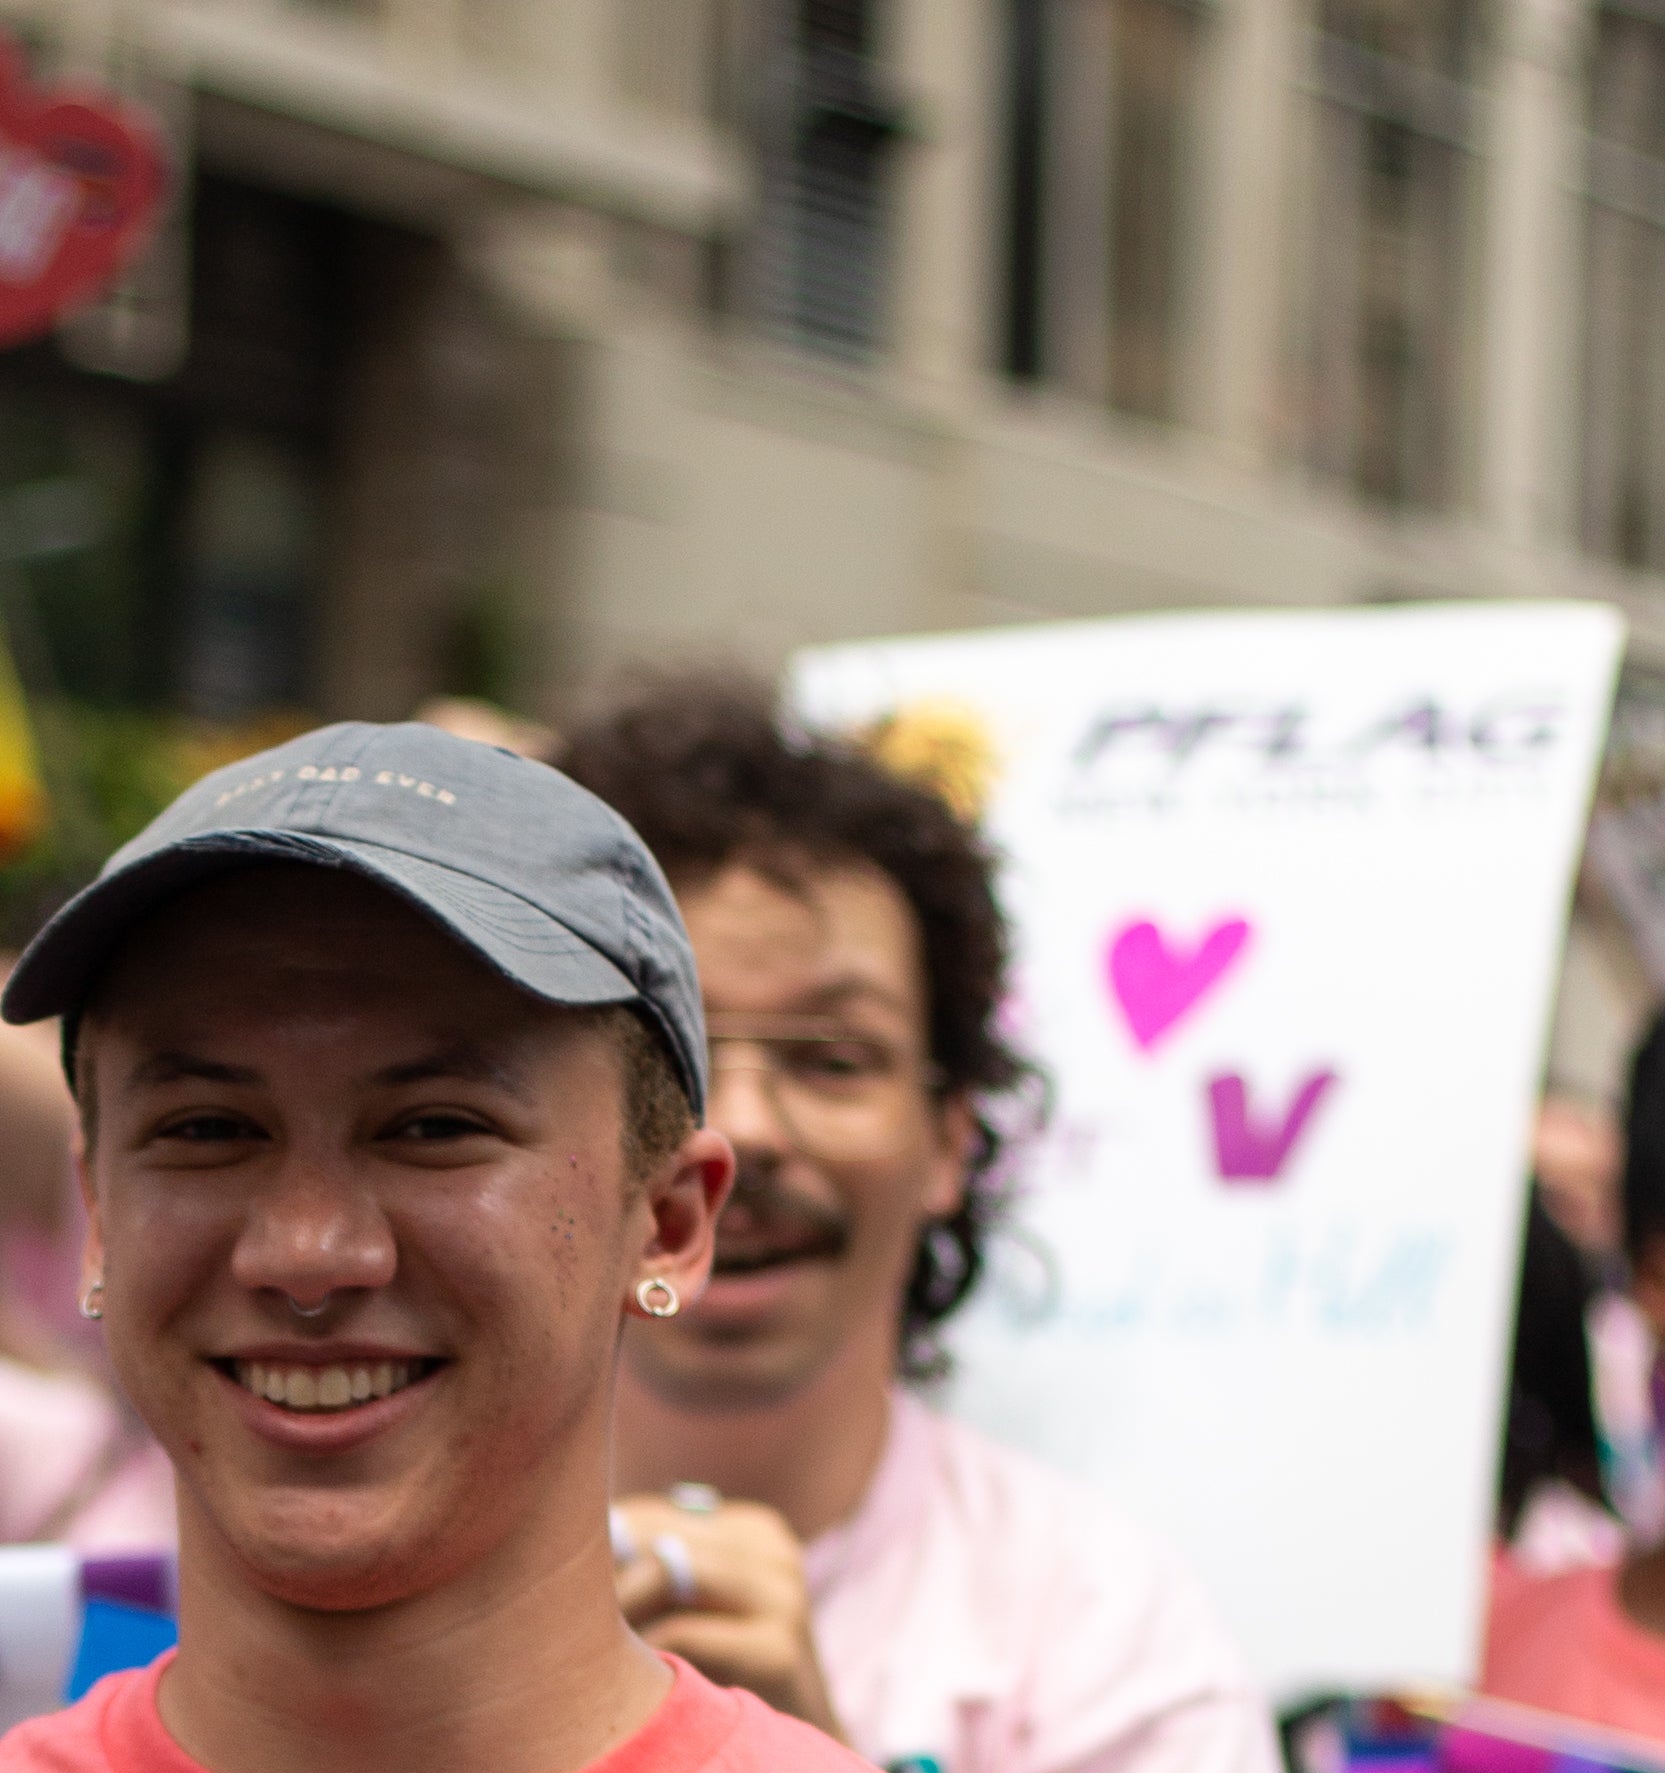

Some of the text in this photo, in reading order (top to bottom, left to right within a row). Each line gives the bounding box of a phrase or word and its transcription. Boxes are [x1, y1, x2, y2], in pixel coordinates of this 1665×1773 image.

[1070, 690, 1566, 769] PFLAG
[296, 765, 361, 782] DAD
[375, 769, 457, 806] EVER
